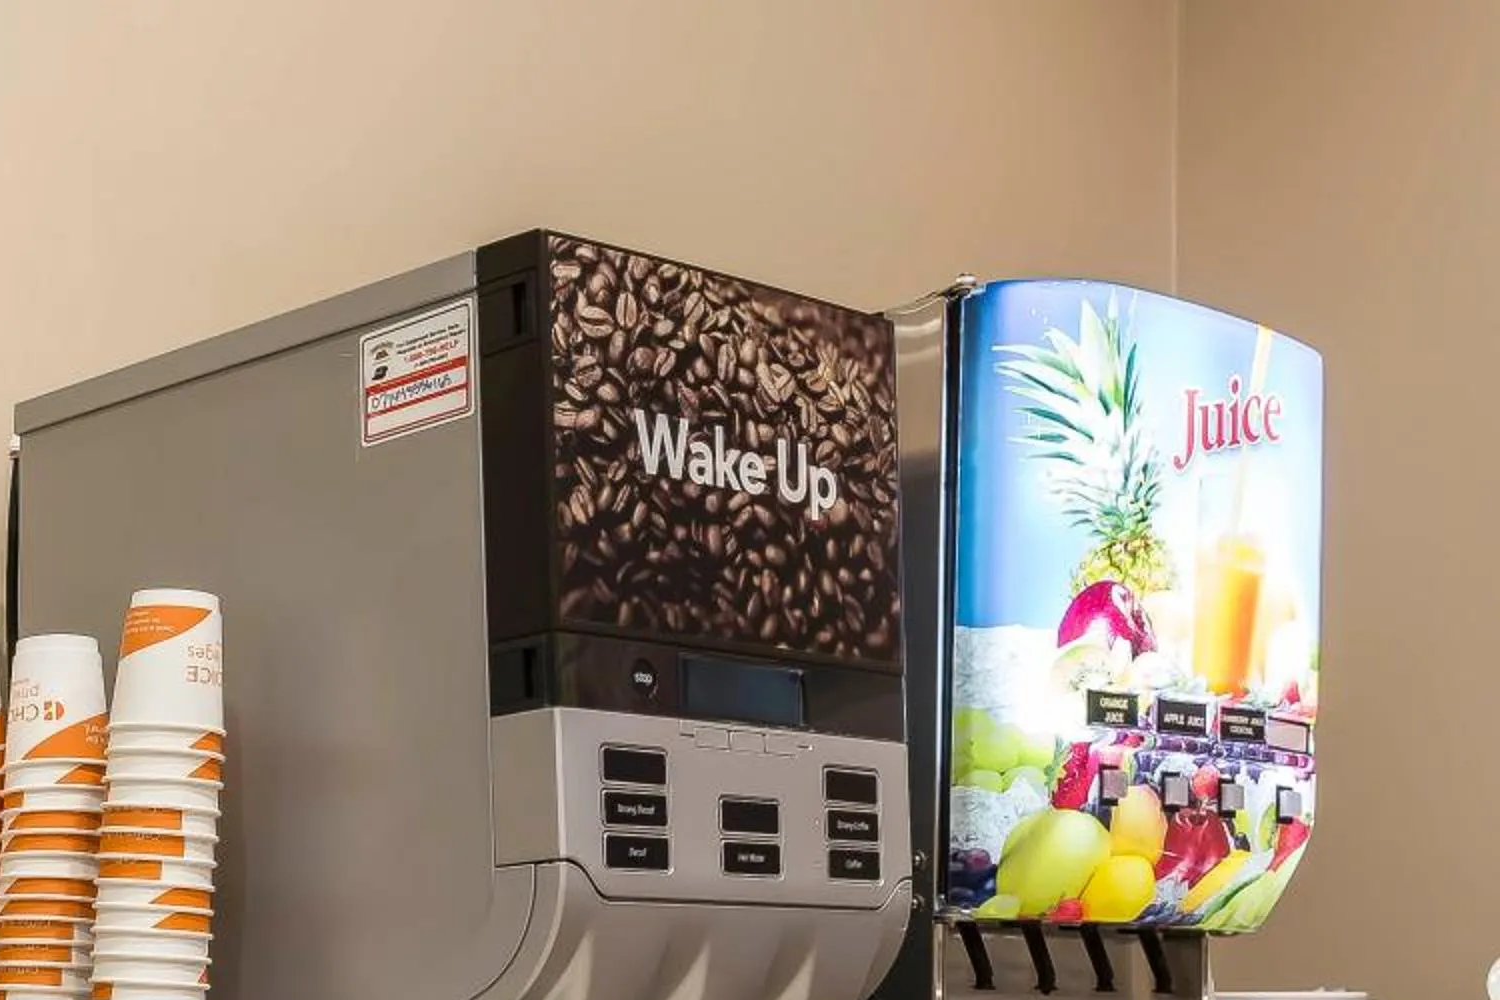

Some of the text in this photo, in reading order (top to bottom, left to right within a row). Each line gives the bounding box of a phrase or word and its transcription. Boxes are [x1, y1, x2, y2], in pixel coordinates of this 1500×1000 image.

[634, 408, 837, 521] Wake Up
[1173, 379, 1281, 470] Juice
[1163, 713, 1205, 727] APPLE JUICE
